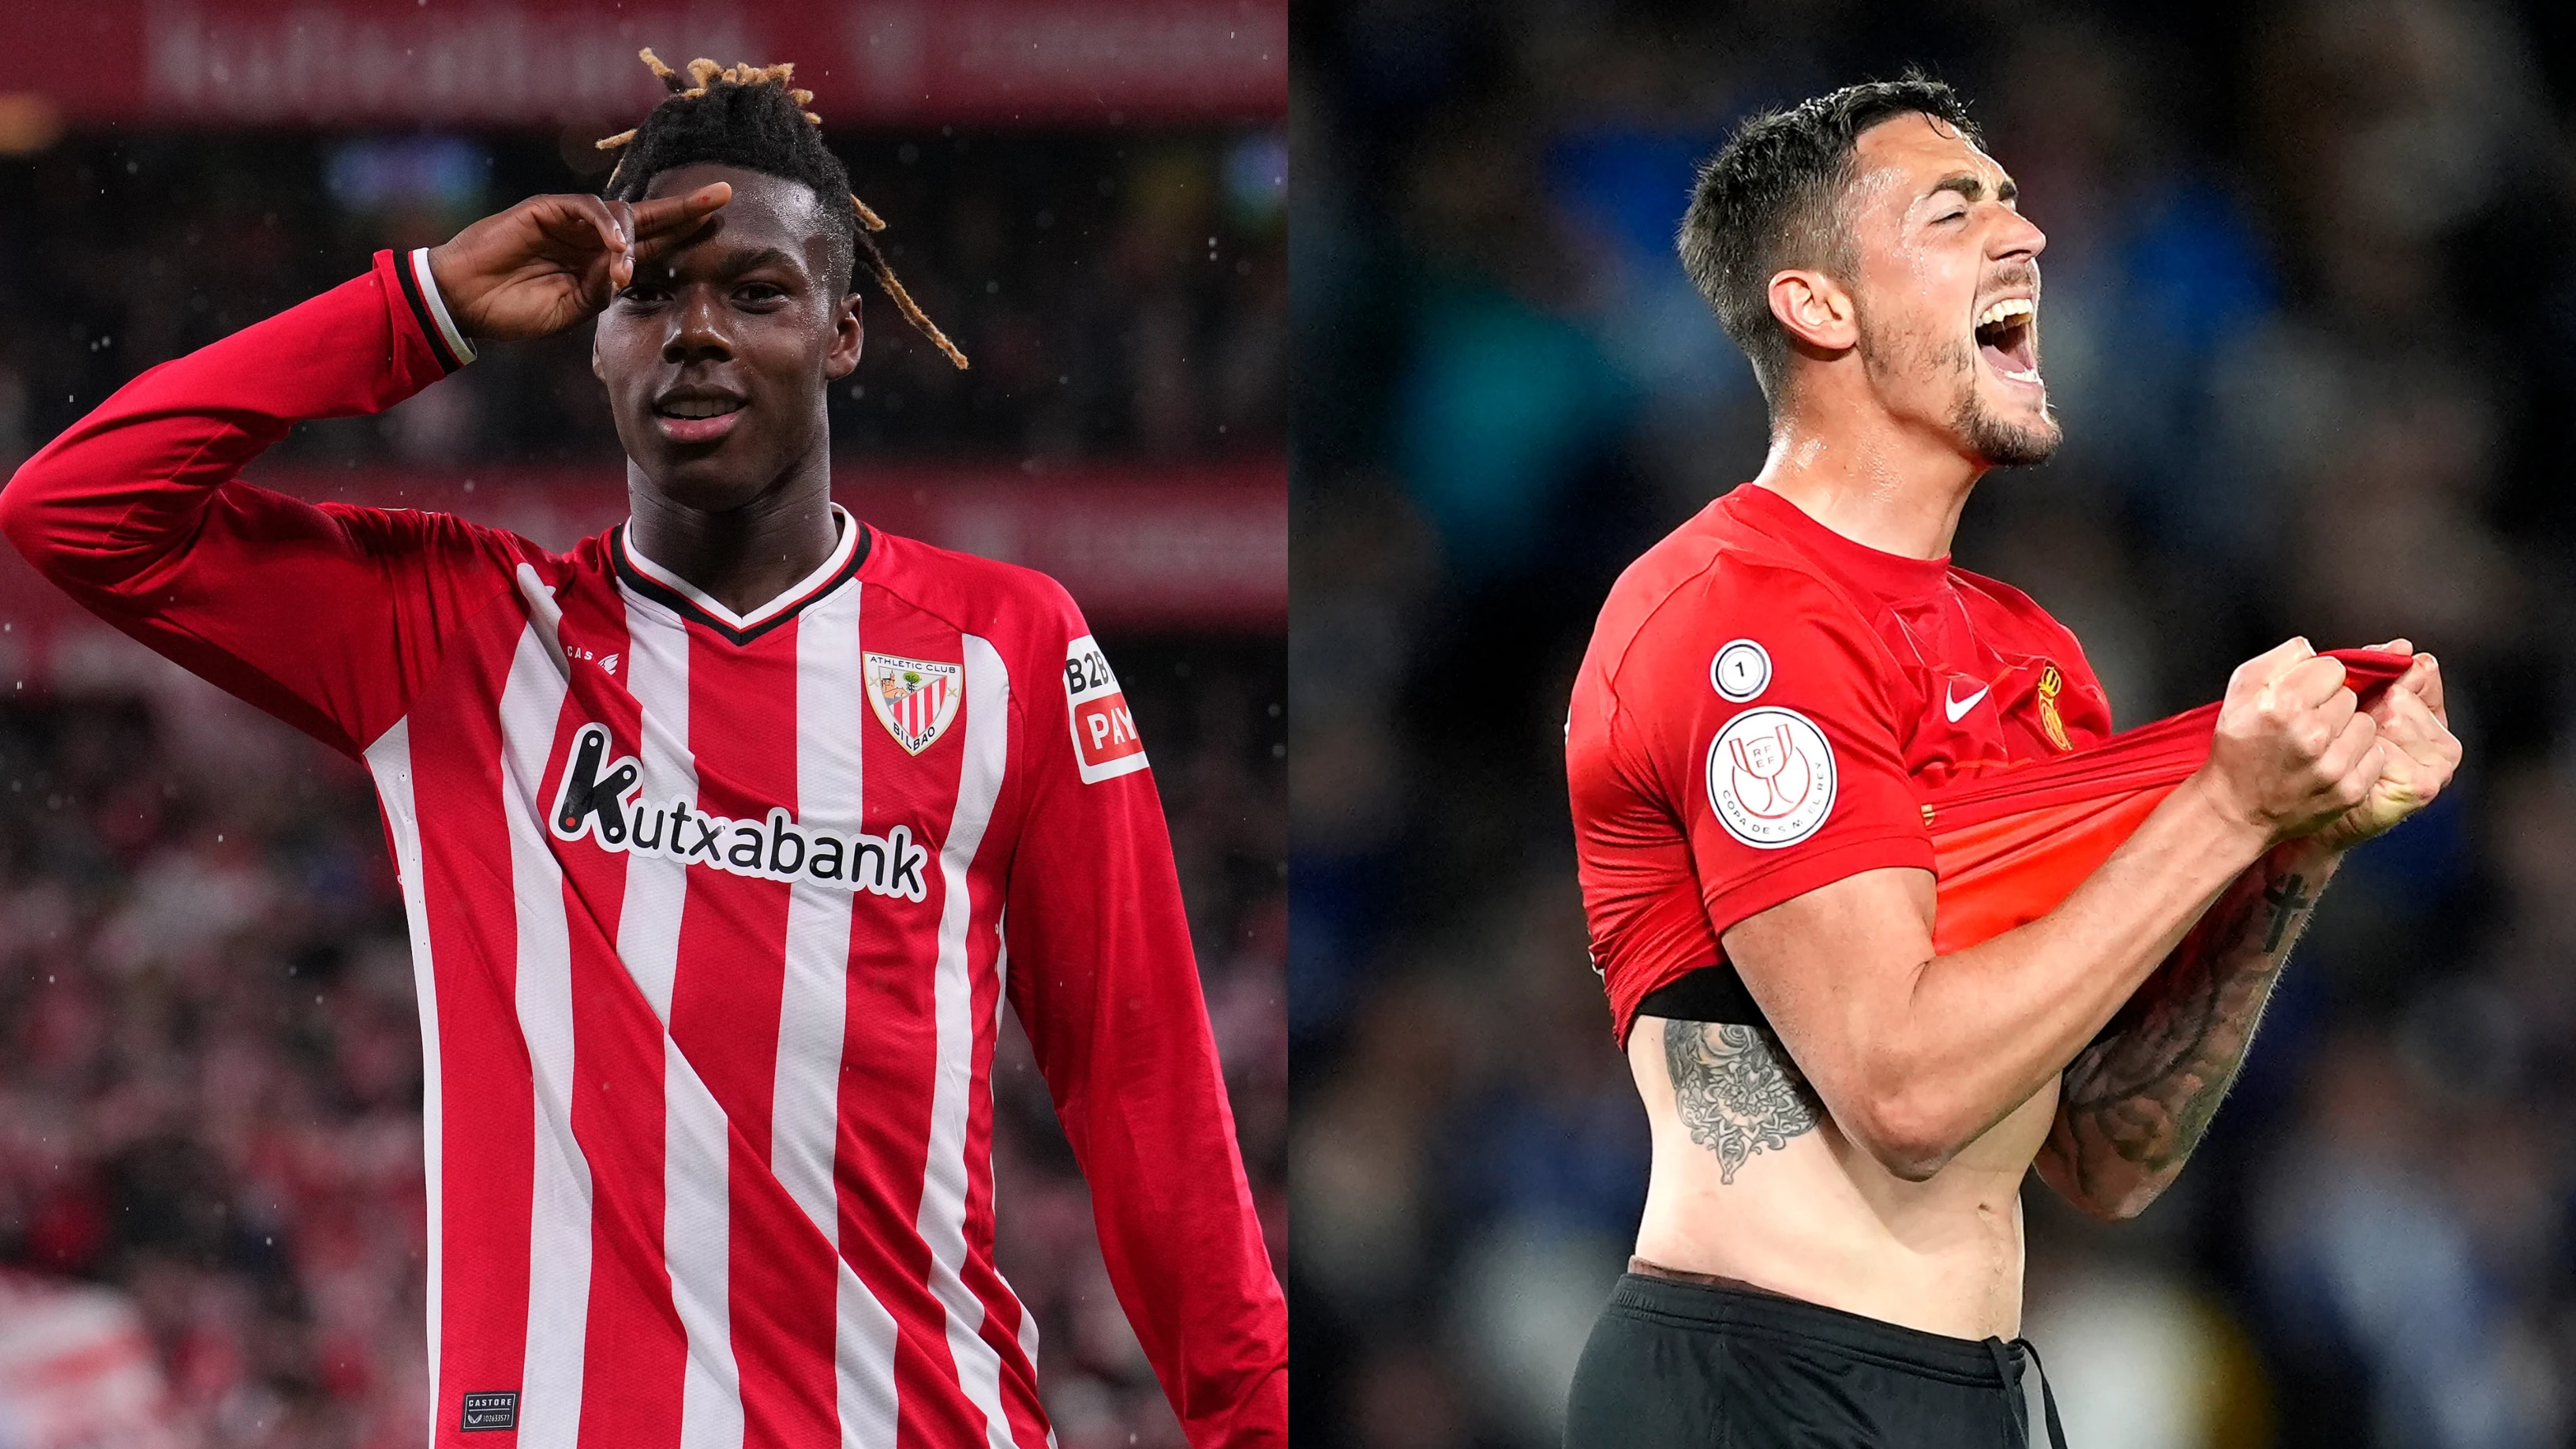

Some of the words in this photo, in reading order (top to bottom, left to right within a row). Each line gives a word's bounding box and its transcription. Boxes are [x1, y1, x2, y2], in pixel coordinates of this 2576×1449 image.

[870, 656, 923, 670] ATHLETIC
[926, 664, 957, 674] CLUB
[1066, 650, 1115, 695] B2B
[1735, 661, 1744, 677] 1
[893, 722, 935, 751] BILBAO
[1086, 705, 1137, 751] PAY
[1723, 790, 1747, 826] COPA
[1751, 824, 1771, 835] DE
[1815, 762, 1824, 791] REY
[468, 1398, 512, 1407] CASTORE
